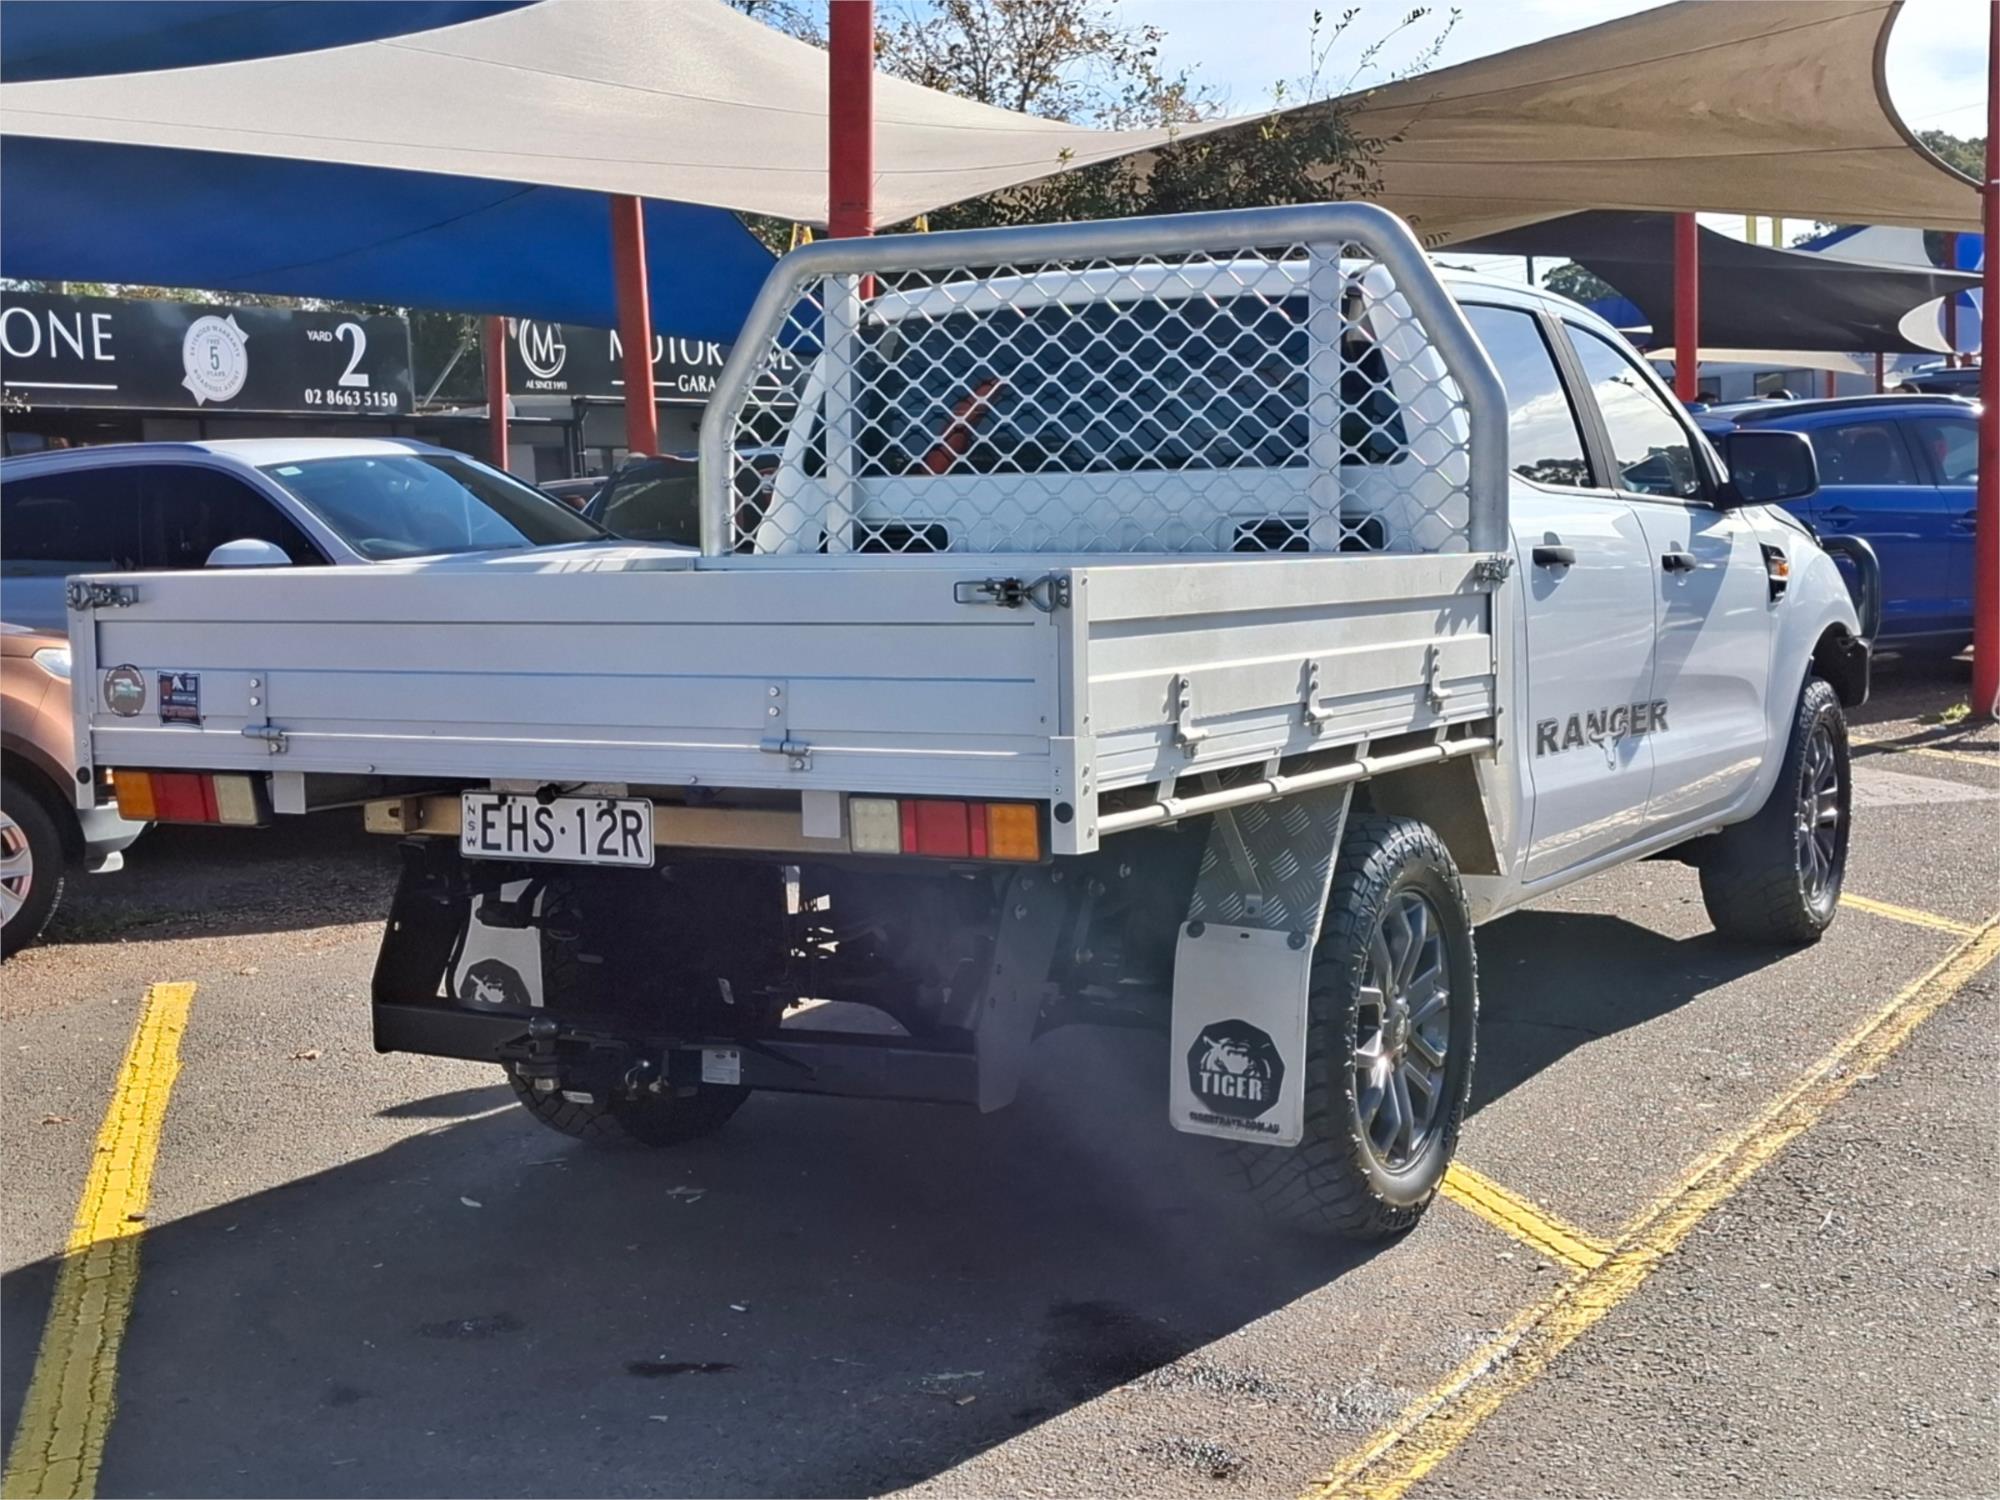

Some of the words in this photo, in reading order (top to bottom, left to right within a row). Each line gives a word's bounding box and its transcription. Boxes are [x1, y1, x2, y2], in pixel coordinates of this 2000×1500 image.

[0, 307, 115, 360] ONE
[210, 346, 220, 370] 5
[307, 330, 333, 342] YARD
[335, 322, 370, 387] 2
[305, 388, 323, 404] 02
[326, 389, 360, 406] 8663
[364, 391, 398, 407] 5150
[1536, 699, 1670, 758] RANGER
[1199, 1071, 1262, 1101] TIGER
